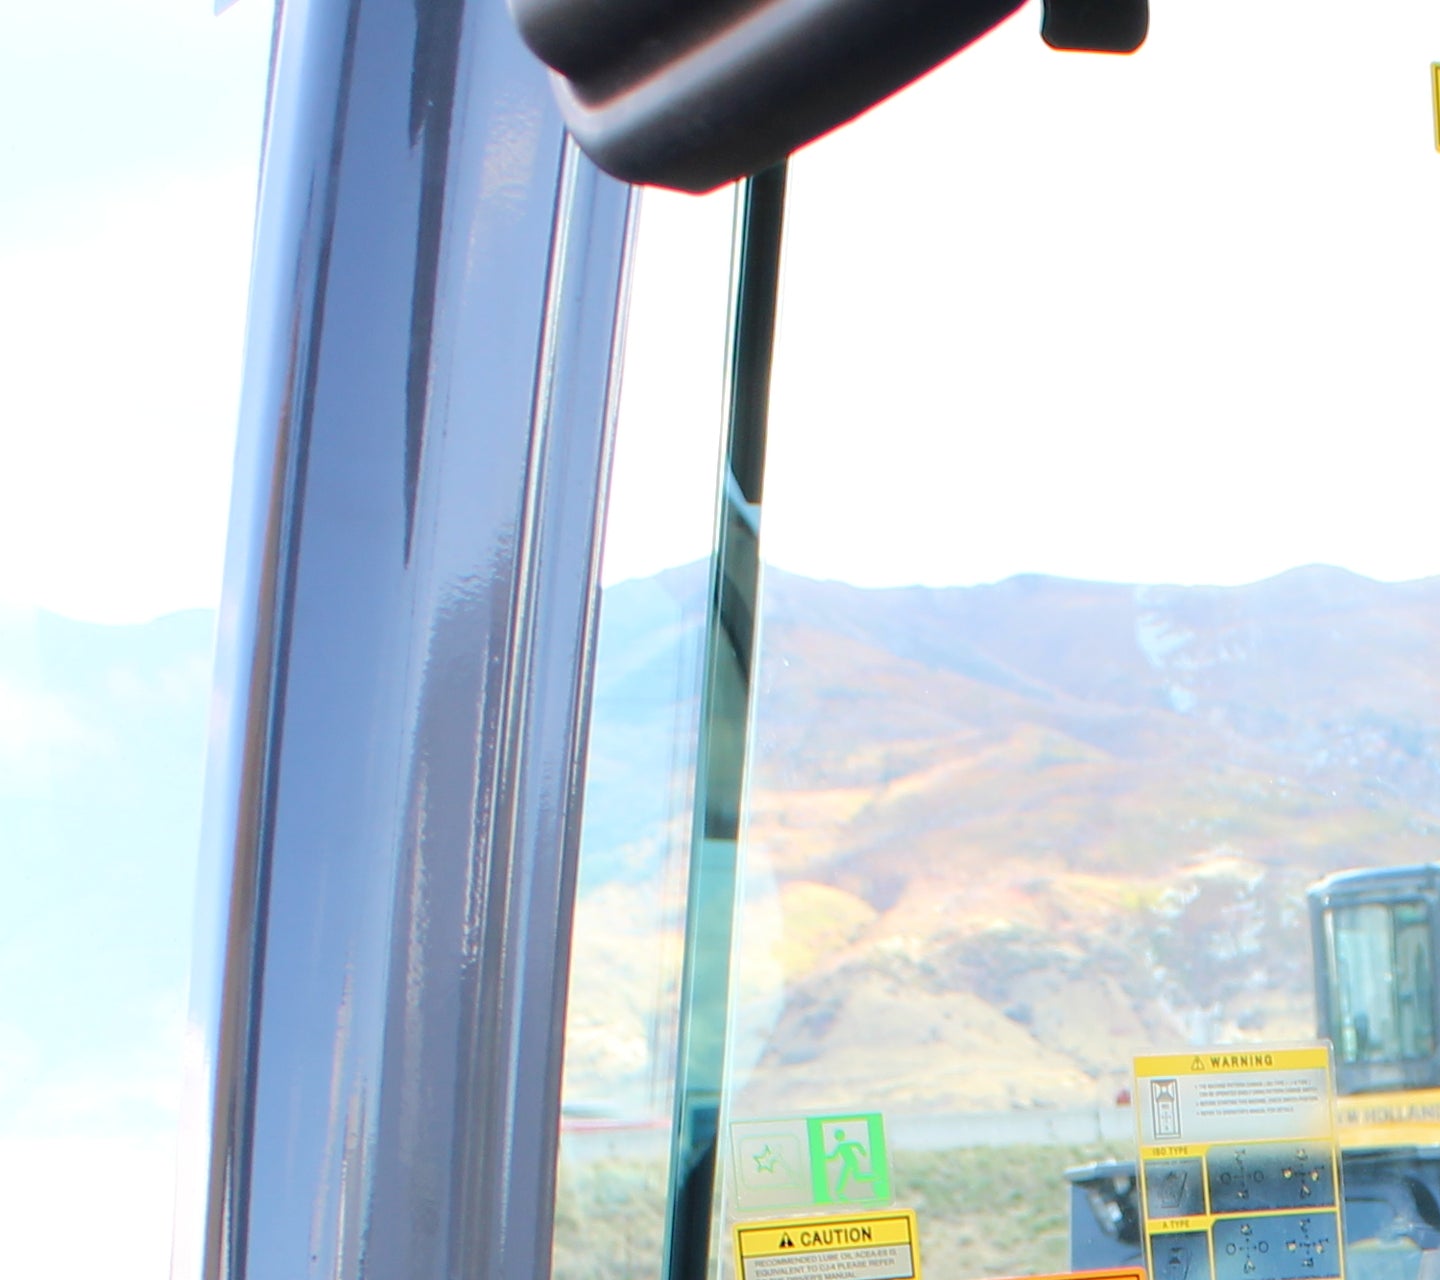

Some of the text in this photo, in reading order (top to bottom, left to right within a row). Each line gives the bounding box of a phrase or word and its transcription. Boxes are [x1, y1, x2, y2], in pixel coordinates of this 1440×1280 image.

[1210, 1054, 1273, 1068] WARNING
[1168, 1145, 1188, 1156] TYPE
[1171, 1219, 1190, 1229] TYPE
[800, 1226, 872, 1247] CAUTION
[755, 1254, 818, 1267] RECOMMENDED
